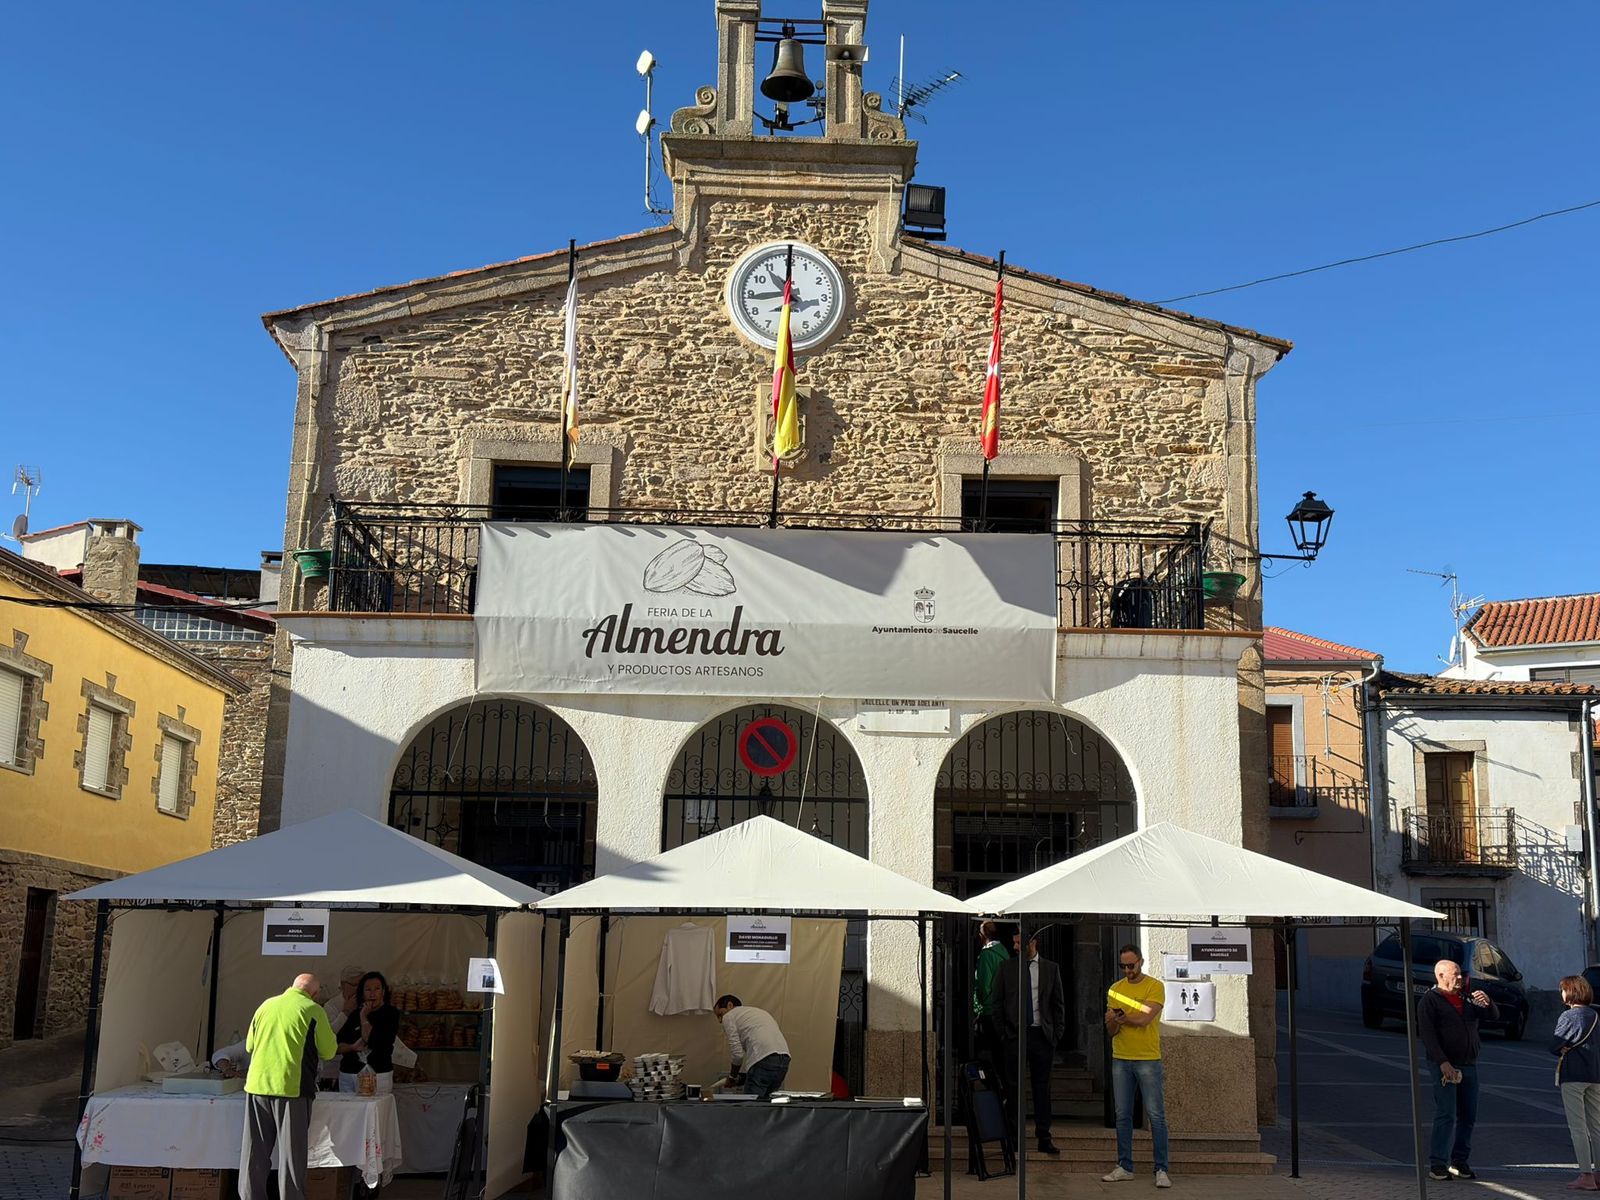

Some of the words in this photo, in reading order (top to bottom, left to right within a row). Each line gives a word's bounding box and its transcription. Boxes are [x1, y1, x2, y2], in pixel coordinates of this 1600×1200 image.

[764, 263, 774, 271] 11
[802, 263, 808, 271] 1
[754, 275, 766, 284] 10
[815, 276, 823, 285] 2
[747, 290, 755, 299] 9
[820, 293, 829, 302] 3
[751, 306, 759, 316] 8
[813, 310, 821, 319] 4
[764, 319, 772, 328] 7
[801, 320, 810, 330] 5
[647, 607, 678, 617] FERIA
[682, 608, 696, 618] DE
[699, 608, 713, 618] LA
[582, 603, 785, 659] Almendra
[872, 626, 933, 635] Ayuntamiento
[942, 627, 979, 635] Saucelle
[607, 664, 615, 675] Y
[618, 664, 691, 676] PRODUCTOS
[694, 666, 764, 677] ARTESANOS
